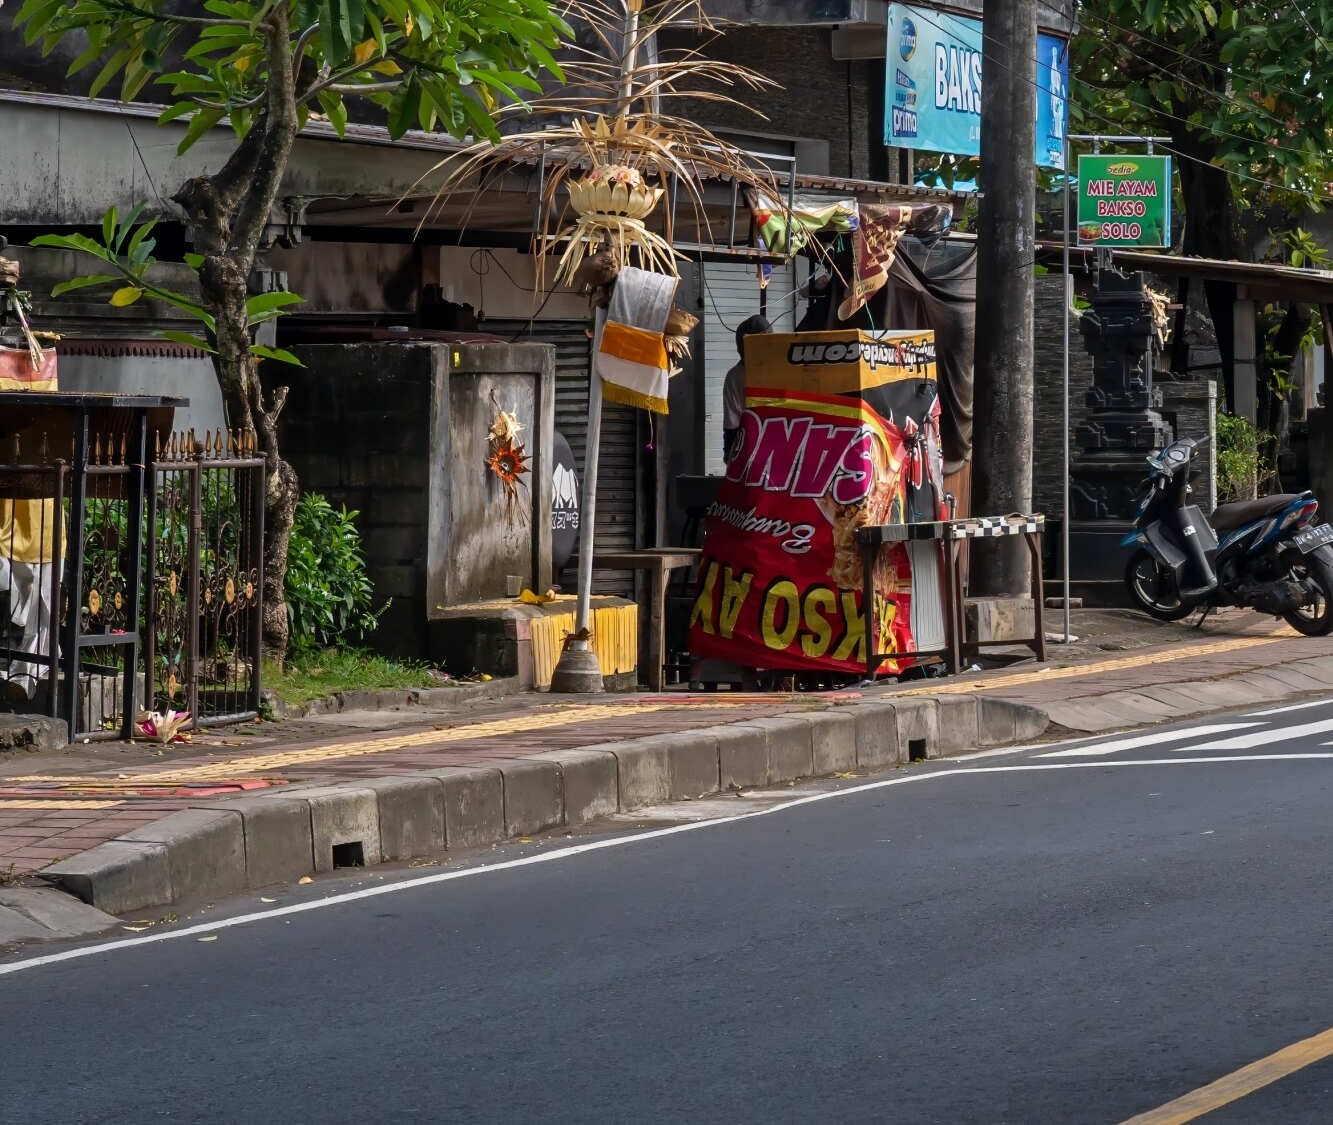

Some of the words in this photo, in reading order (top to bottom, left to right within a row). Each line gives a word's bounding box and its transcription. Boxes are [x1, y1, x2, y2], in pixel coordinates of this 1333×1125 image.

[1087, 180, 1114, 196] MIE
[1116, 180, 1157, 196] AYAM
[1098, 200, 1146, 217] BAKSO
[1102, 222, 1141, 239] SOLO
